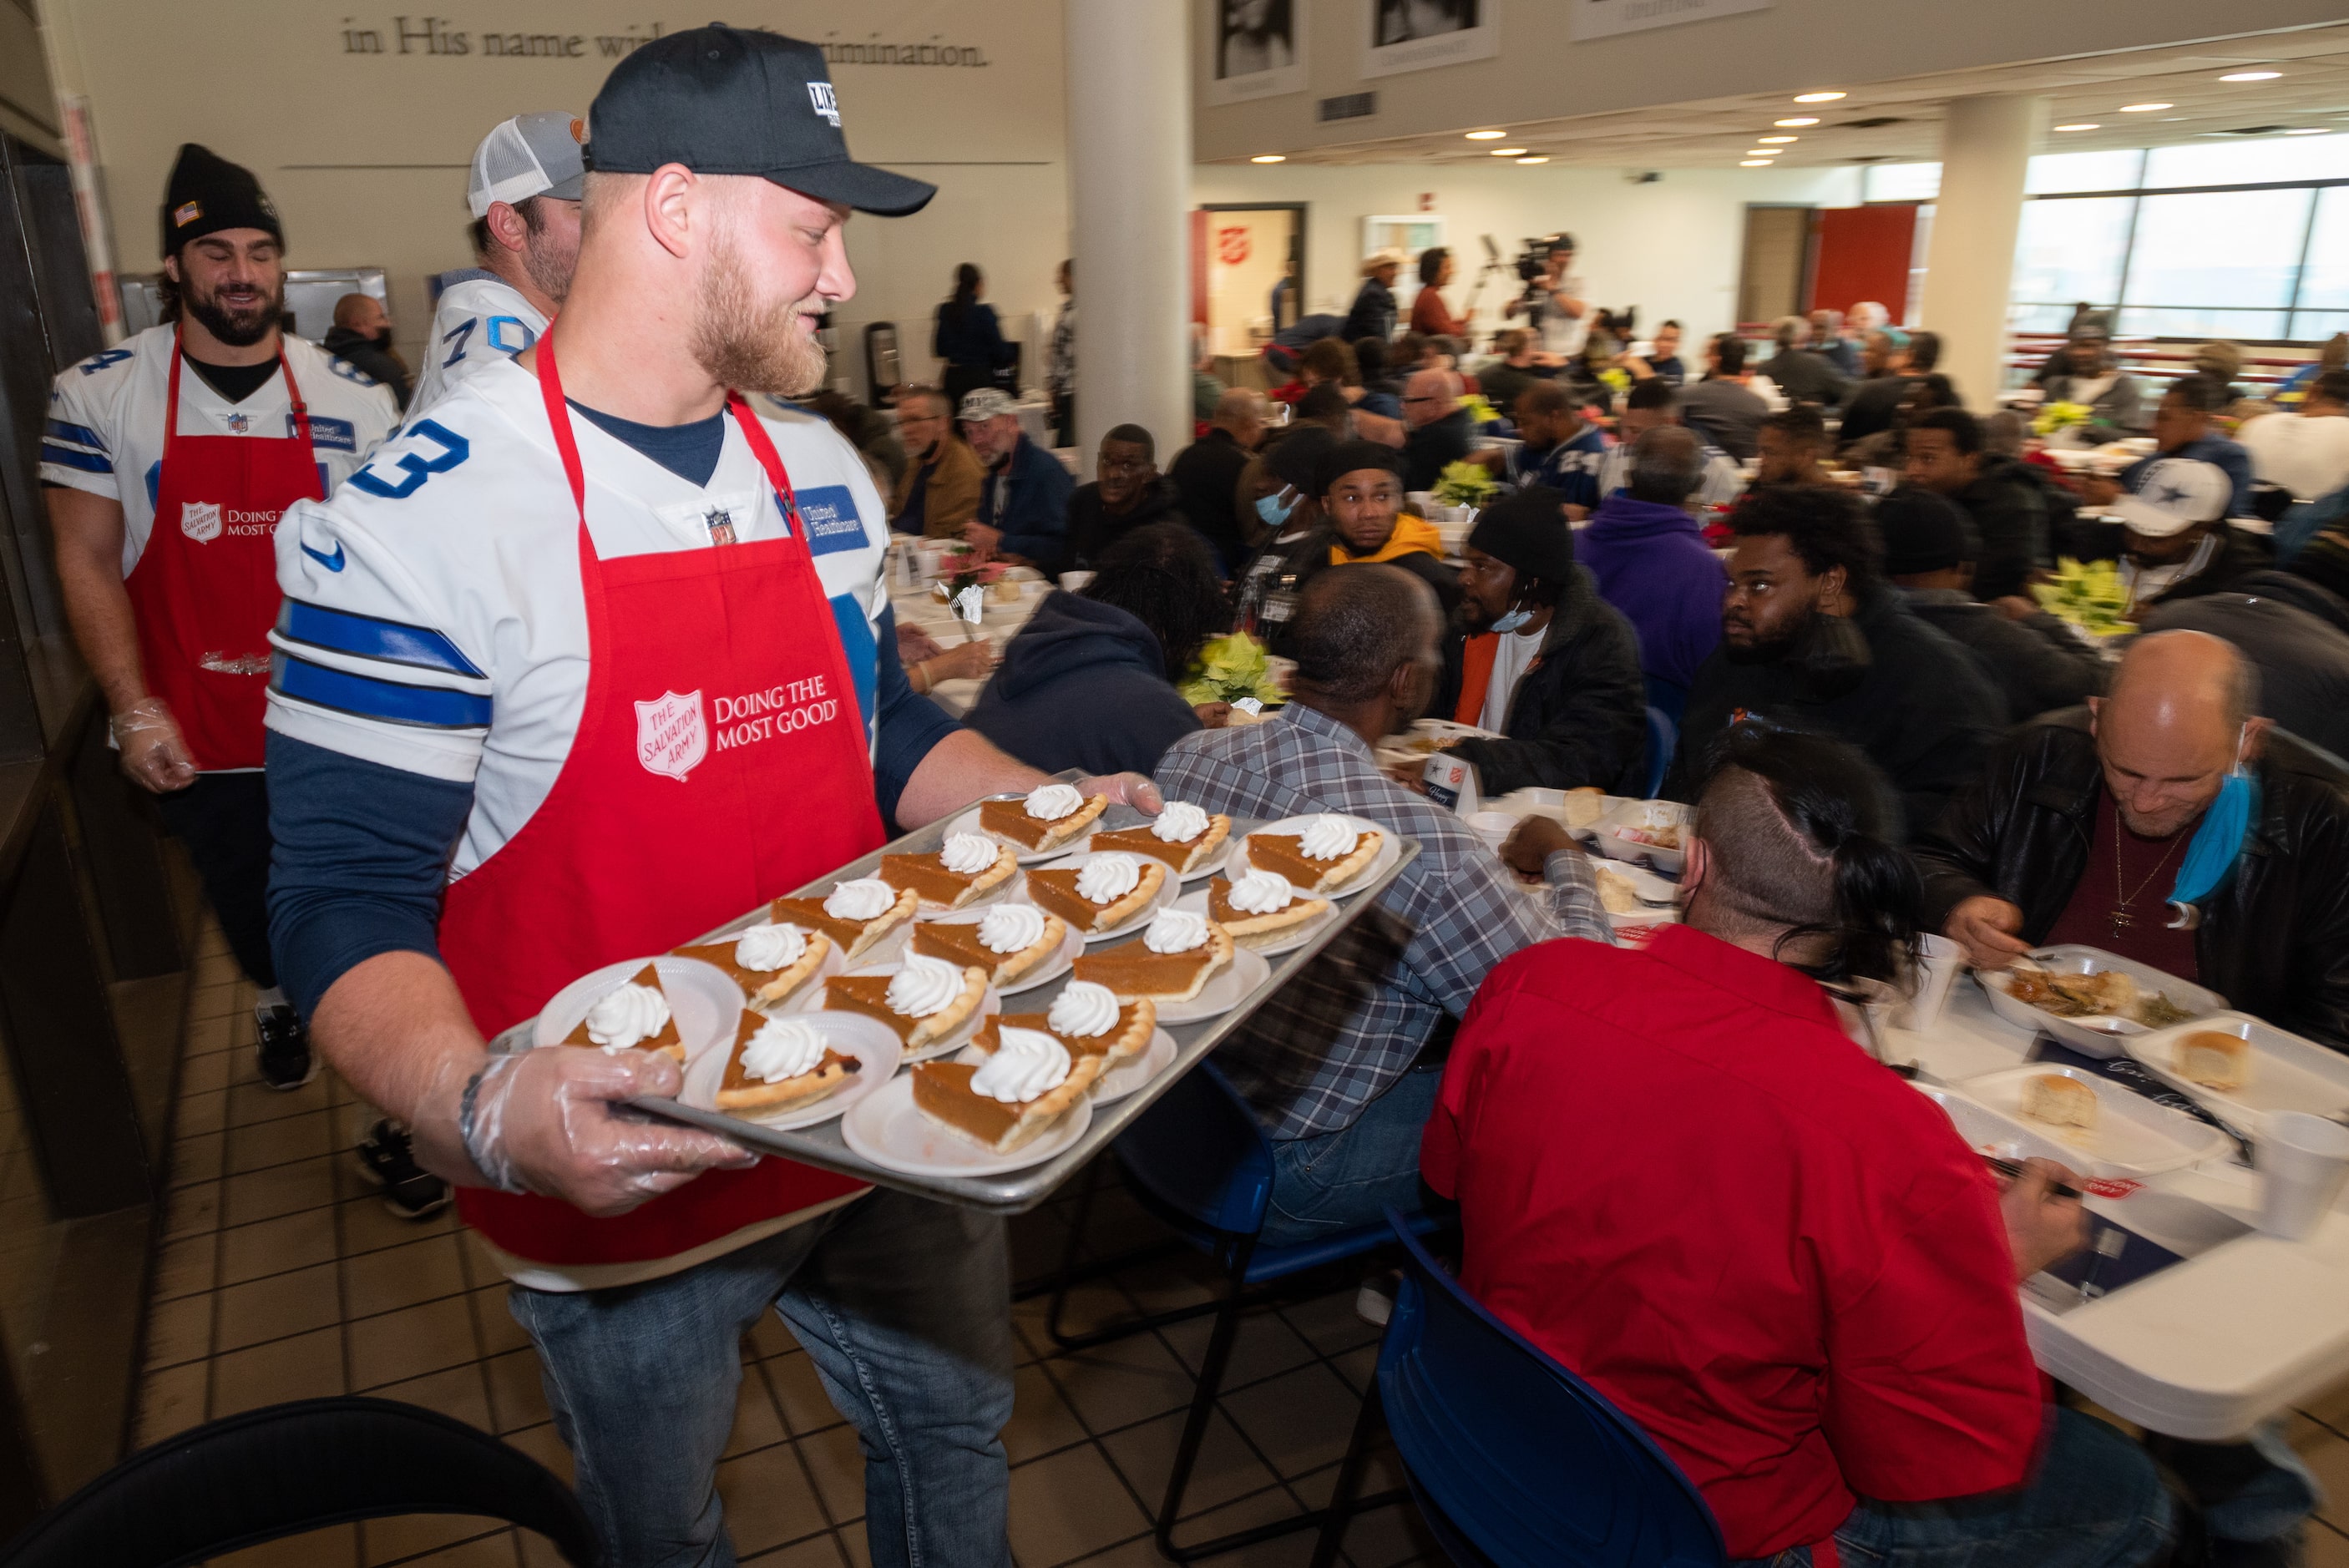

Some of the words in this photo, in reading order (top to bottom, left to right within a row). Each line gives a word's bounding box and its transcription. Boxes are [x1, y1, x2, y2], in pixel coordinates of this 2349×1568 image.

[341, 16, 384, 55] in
[394, 16, 470, 56] His
[482, 32, 585, 58] name
[184, 508, 217, 532] SALVATION
[189, 506, 204, 518] THE
[227, 509, 276, 523] DOING
[802, 503, 838, 521] United
[196, 520, 216, 537] ARMY
[227, 524, 266, 536] MOST
[713, 686, 784, 725] DOING
[787, 675, 827, 704] THE
[650, 701, 675, 731] THE
[716, 716, 773, 752] MOST
[777, 700, 836, 734] GOOD
[644, 700, 698, 763] SALVATION
[667, 726, 698, 769] ARMY
